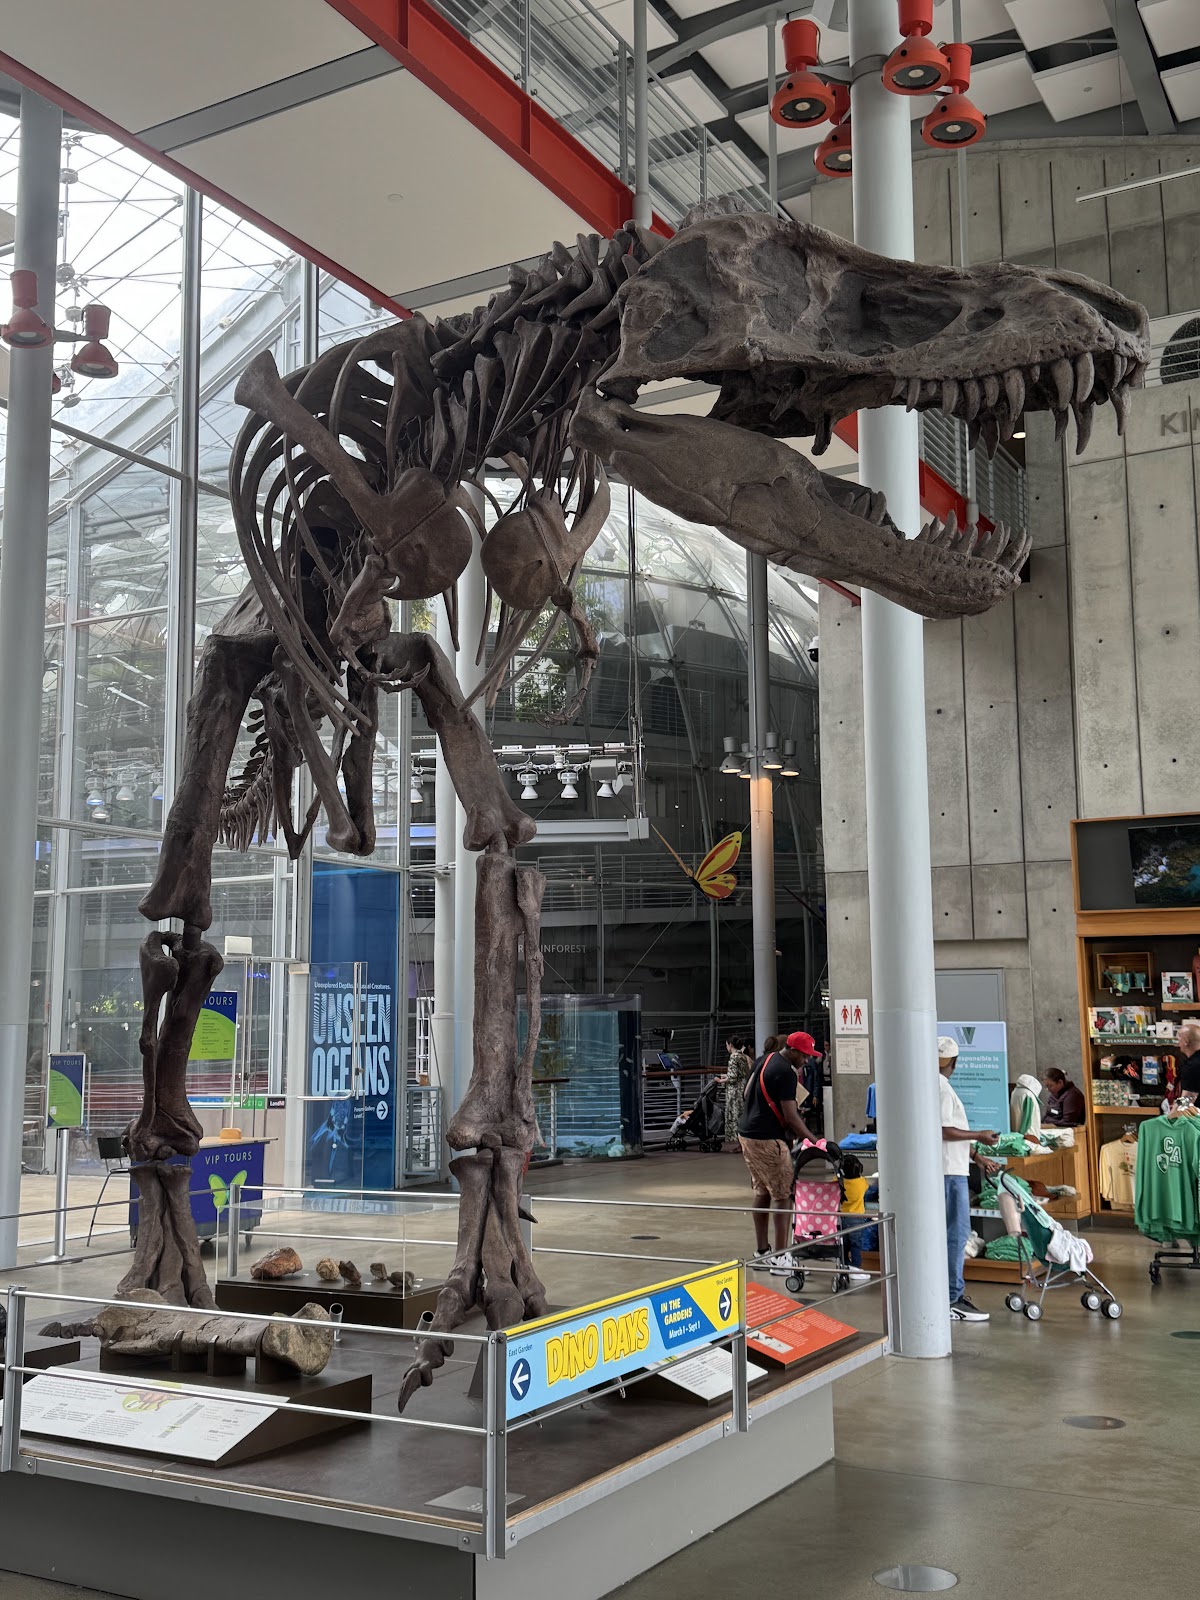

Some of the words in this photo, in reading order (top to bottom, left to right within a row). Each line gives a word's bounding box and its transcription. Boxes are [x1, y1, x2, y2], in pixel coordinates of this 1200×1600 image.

[518, 944, 587, 953] RINFOREST
[313, 993, 391, 1045] UNSEEN
[205, 1155, 220, 1165] VIP
[224, 1151, 252, 1162] TOURS
[660, 1301, 668, 1314] IN
[669, 1297, 681, 1311] THE
[664, 1307, 693, 1326] GARDENS
[668, 1325, 682, 1339] March
[688, 1322, 698, 1333] Sept
[508, 1348, 518, 1358] East
[518, 1343, 533, 1354] Garden
[546, 1323, 599, 1386] DINO
[602, 1306, 650, 1364] DAYS
